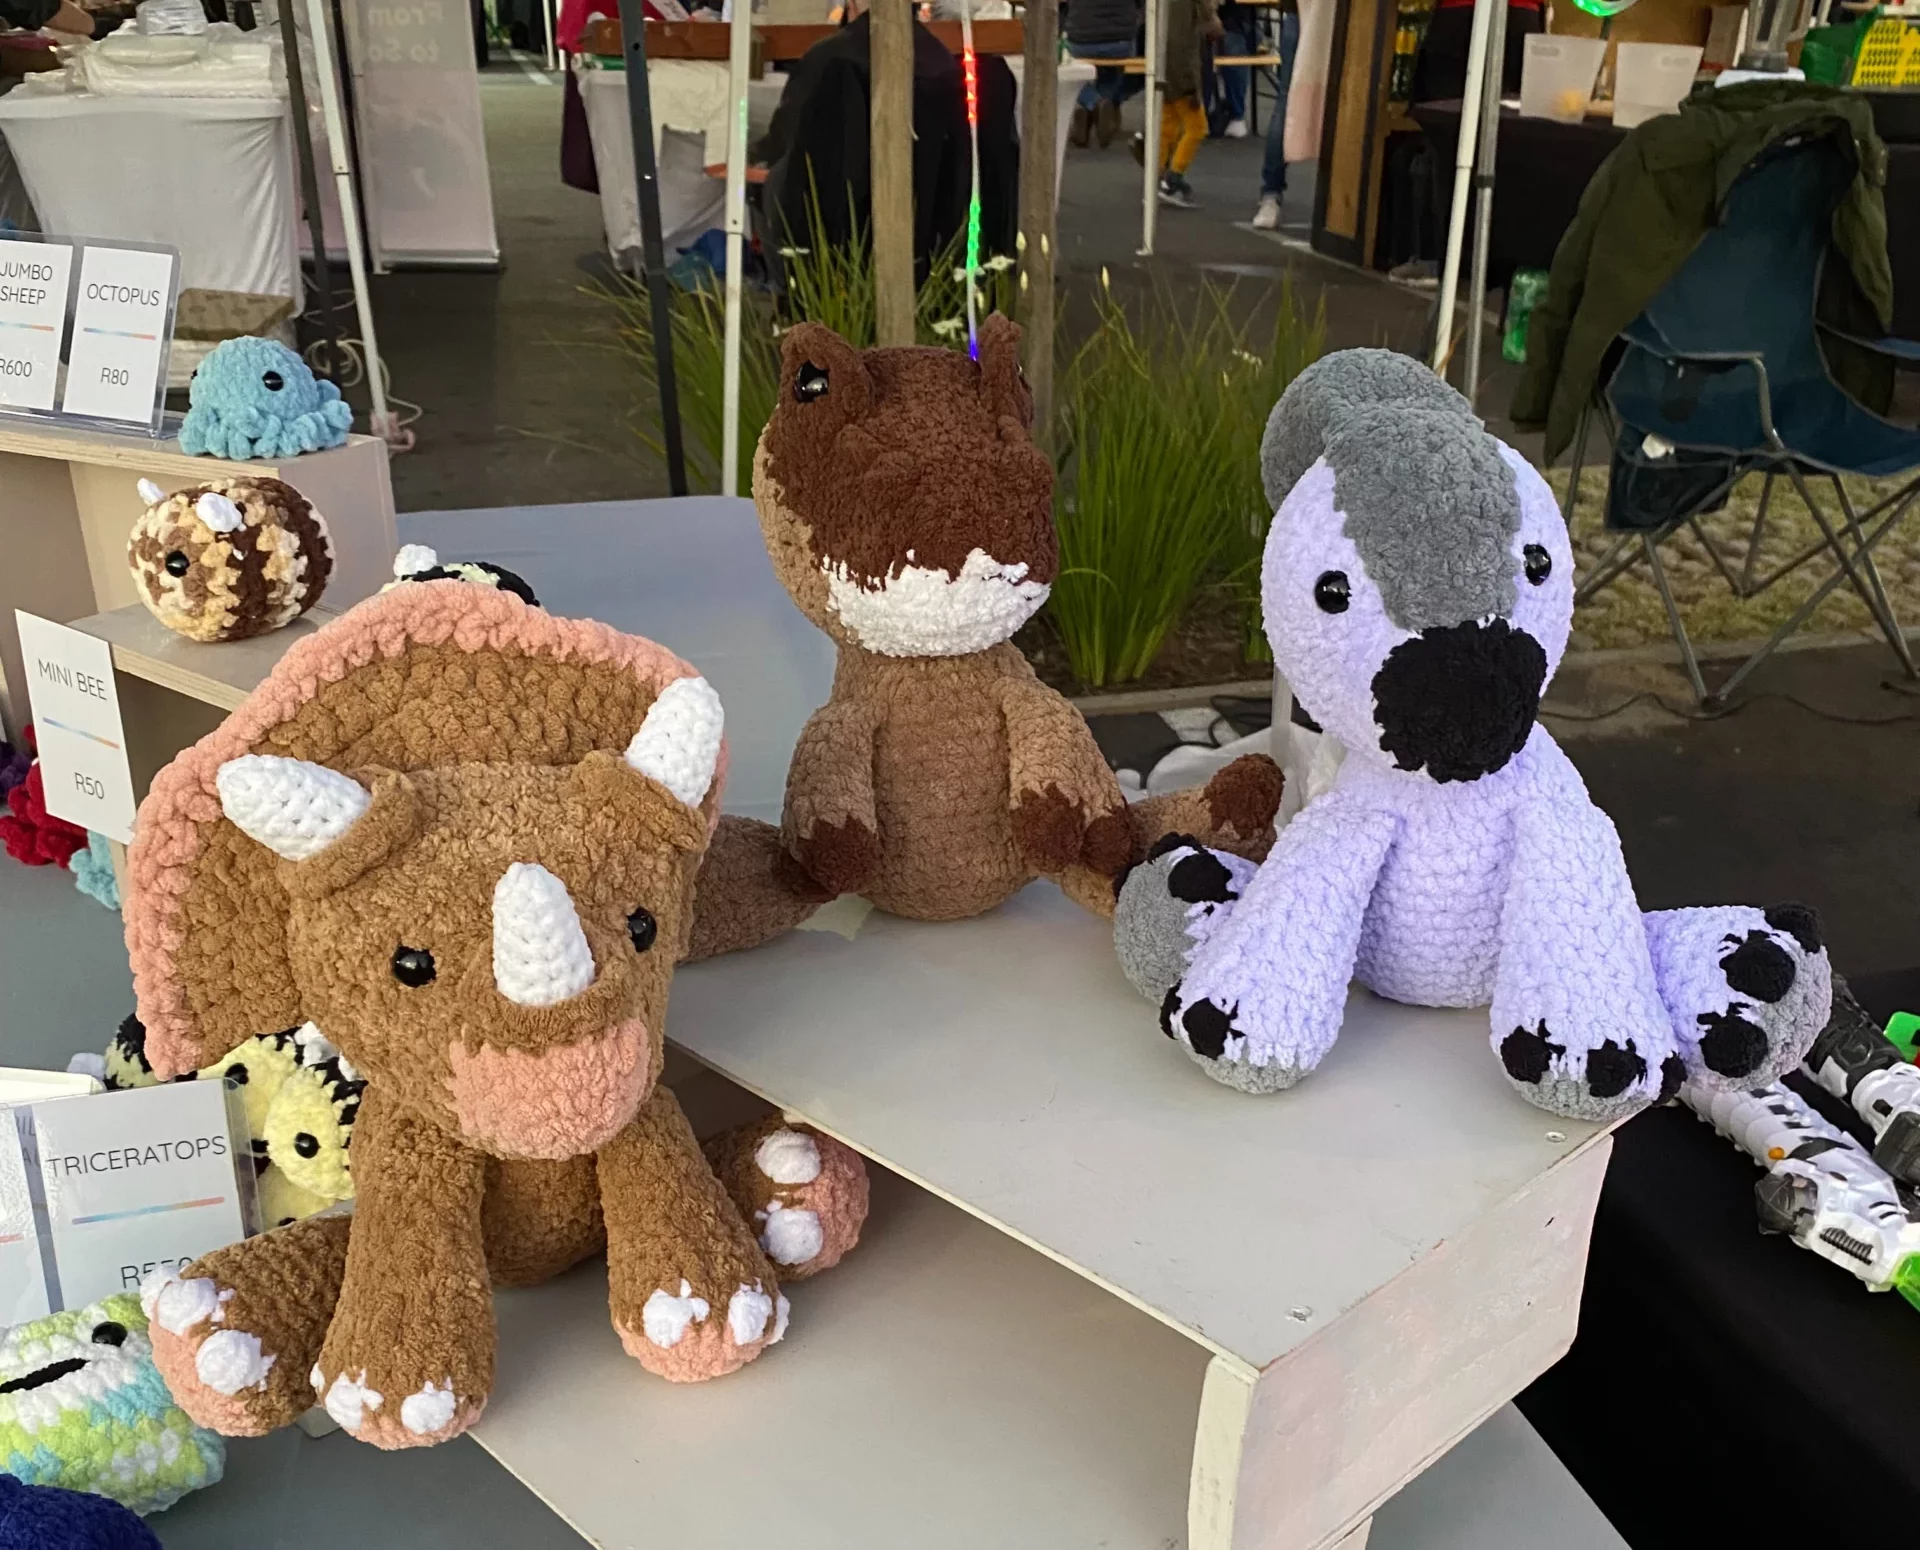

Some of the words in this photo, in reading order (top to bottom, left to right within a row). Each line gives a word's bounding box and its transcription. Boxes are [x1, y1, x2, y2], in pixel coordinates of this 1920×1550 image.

[0, 262, 53, 281] JUMBO
[0, 286, 46, 305] SHEEP
[87, 283, 160, 306] OCTOPUS
[0, 358, 33, 377] R600
[100, 367, 129, 385] R80
[38, 658, 73, 688] MINI
[76, 671, 107, 700] BEE
[74, 772, 105, 800] R50
[46, 1135, 227, 1178] TRICERATOPS
